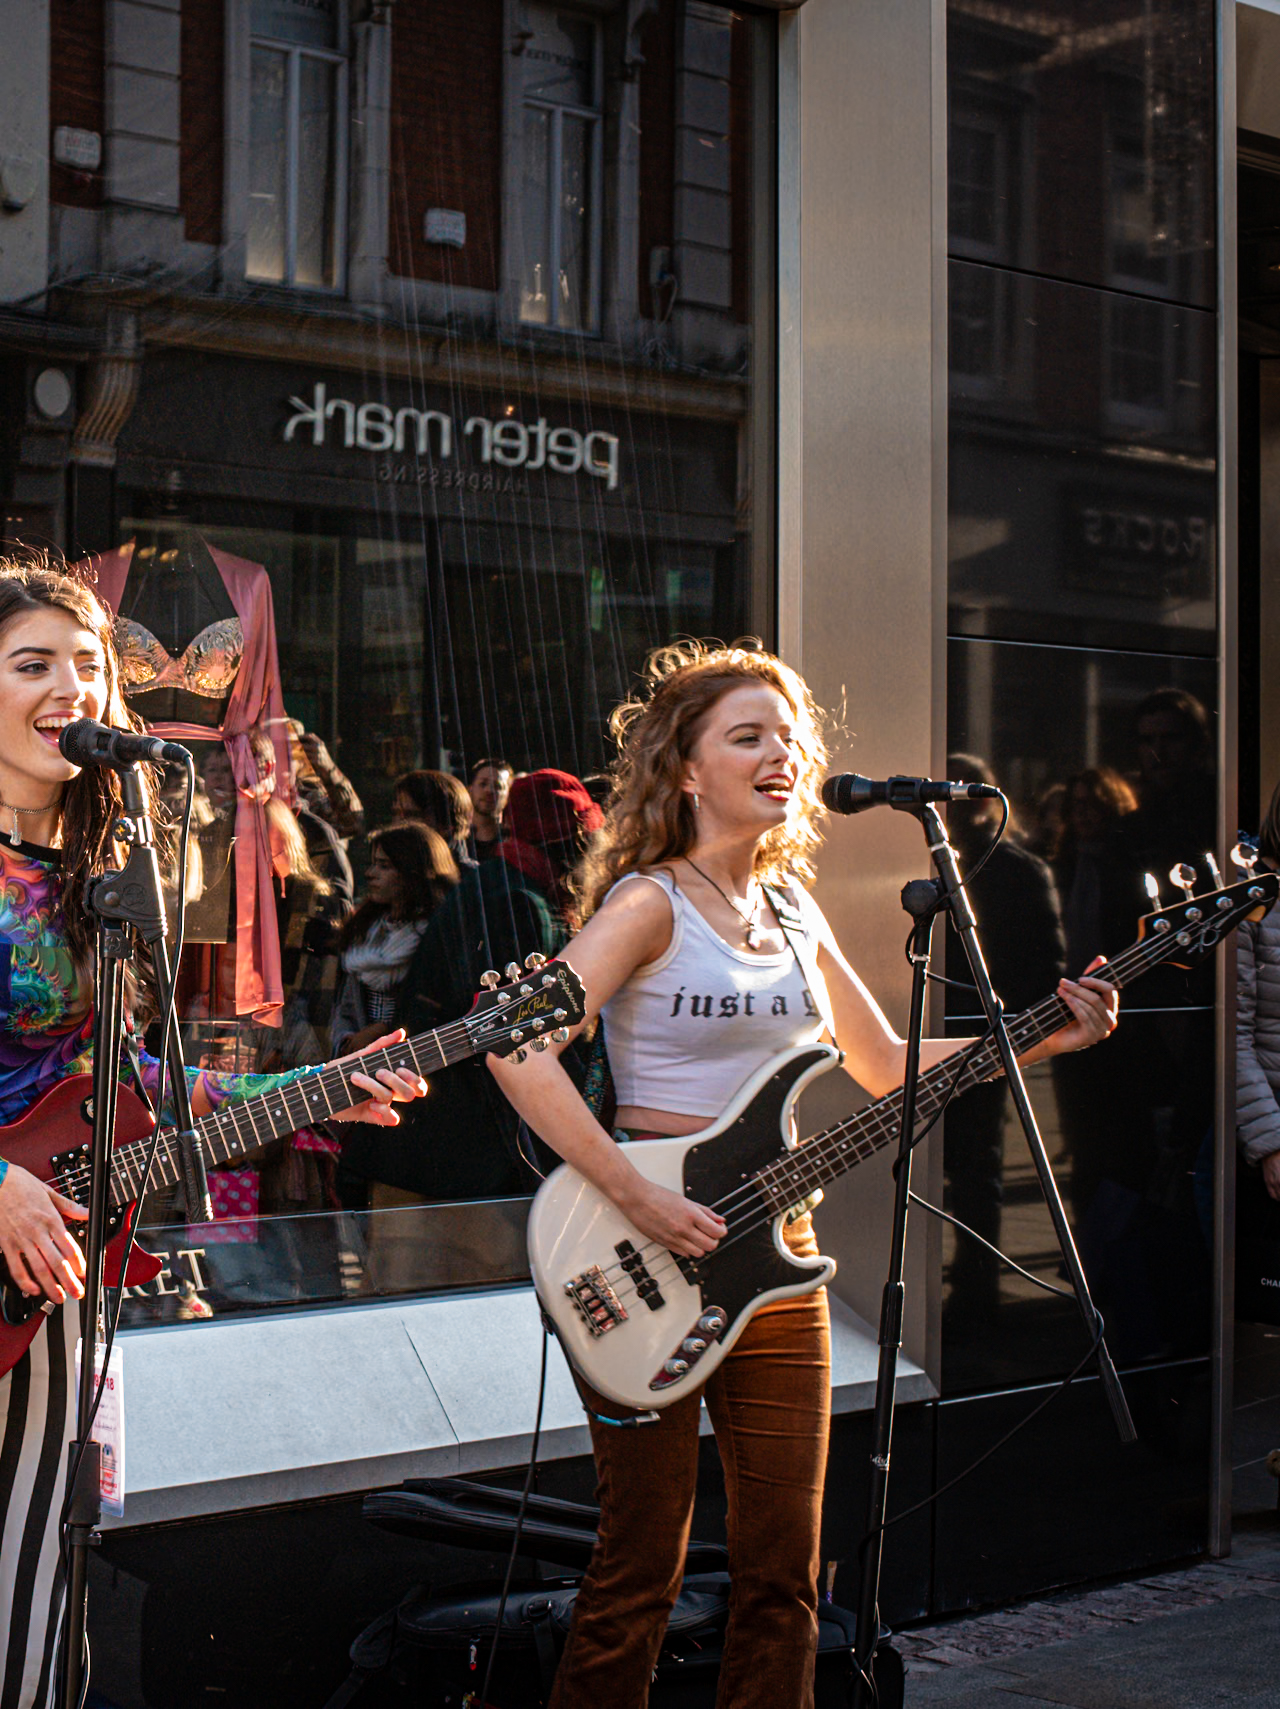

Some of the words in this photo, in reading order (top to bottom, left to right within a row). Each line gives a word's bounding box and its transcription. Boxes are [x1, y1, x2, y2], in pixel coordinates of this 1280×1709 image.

[556, 967, 581, 1015] Epiphone
[669, 986, 756, 1018] just
[771, 994, 789, 1017] a
